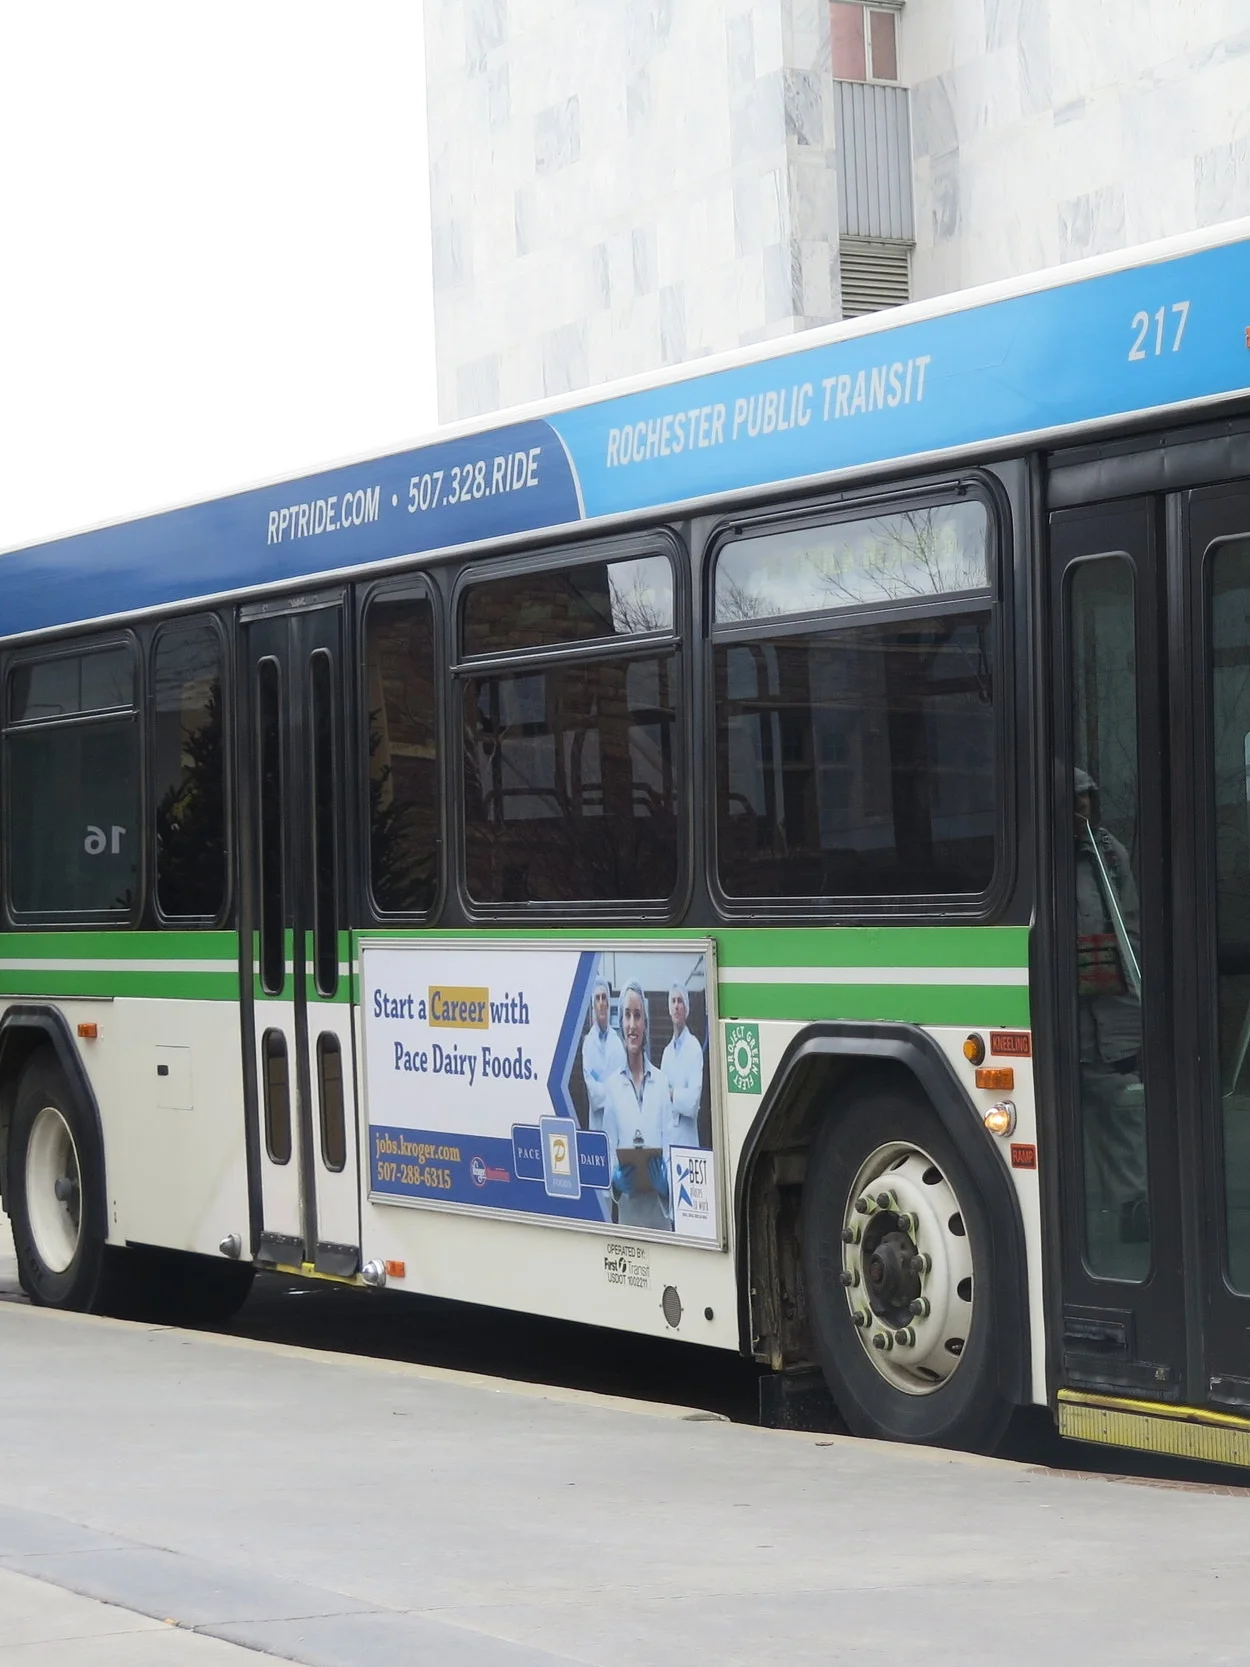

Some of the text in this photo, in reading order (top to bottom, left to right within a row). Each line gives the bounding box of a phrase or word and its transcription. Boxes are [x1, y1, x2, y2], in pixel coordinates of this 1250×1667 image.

[1128, 300, 1190, 361] 217
[606, 355, 931, 468] ROCHESTER PUBLIC TRANSIT
[267, 447, 541, 545] RPTRIDE.COM 507.328.RIDE
[373, 988, 530, 1025] Start a Career with
[728, 1026, 745, 1073] PROJECT
[746, 1031, 759, 1075] GREEN
[992, 1037, 1029, 1052] KNEELING
[394, 1041, 538, 1087] Pace Dairy Foods.
[733, 1074, 754, 1091] FLEET
[375, 1132, 461, 1164] jobs.kroger.com
[518, 1147, 606, 1167] PACE DAIRY
[1012, 1149, 1034, 1163] RAMP
[377, 1161, 451, 1189] 507-288-6315
[689, 1158, 707, 1185] BEST
[604, 1256, 618, 1272] First
[607, 1243, 636, 1258] OPERATED
[607, 1272, 626, 1285] USDOT
